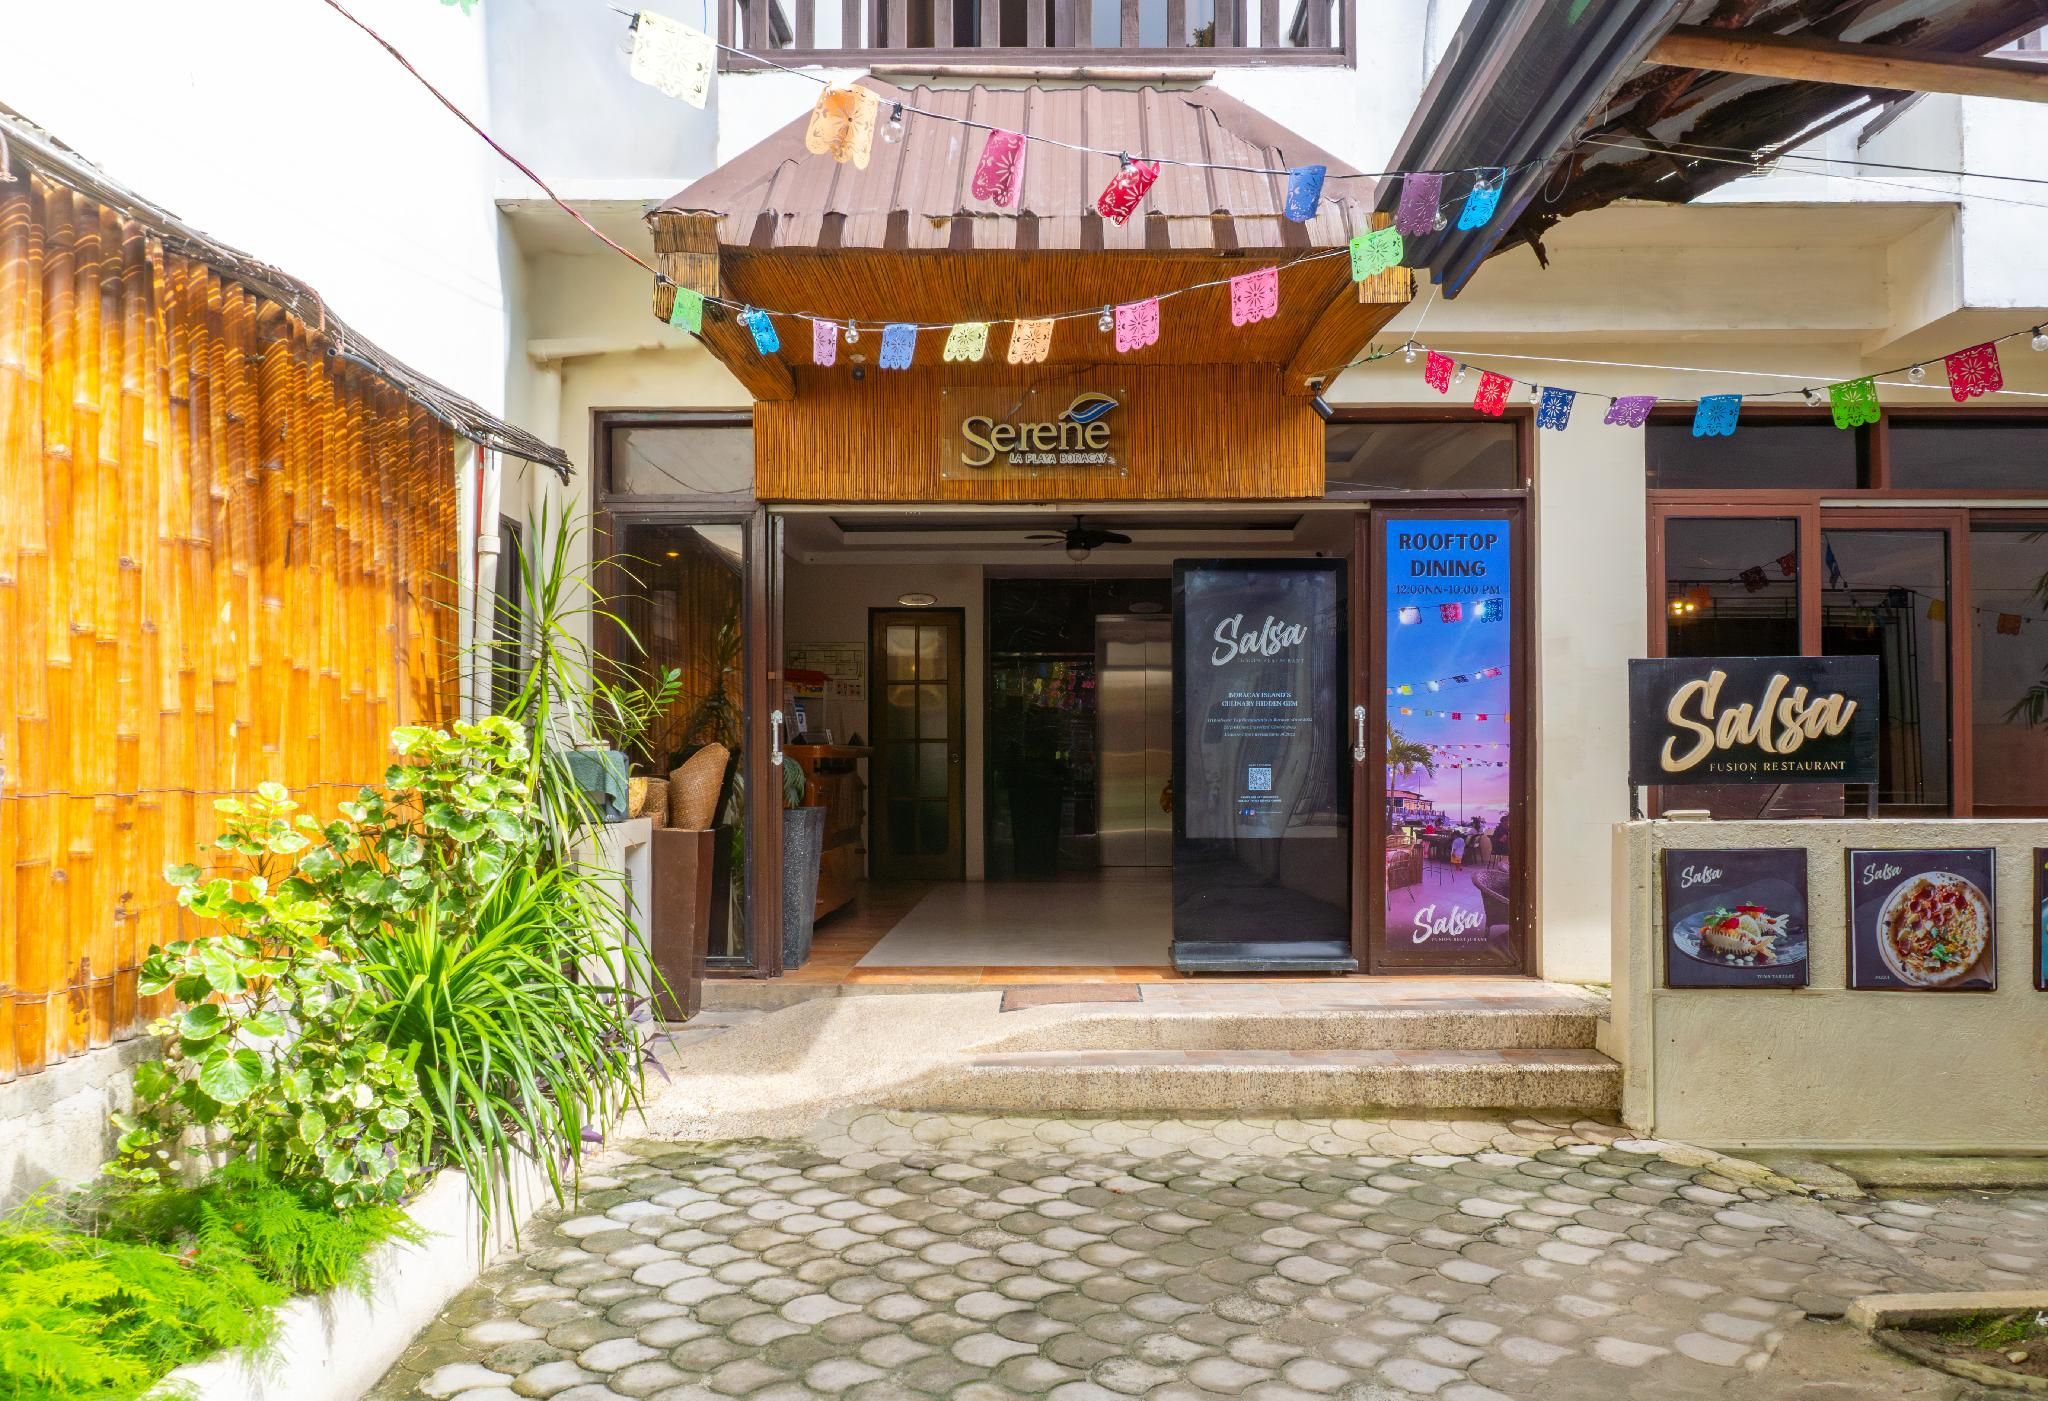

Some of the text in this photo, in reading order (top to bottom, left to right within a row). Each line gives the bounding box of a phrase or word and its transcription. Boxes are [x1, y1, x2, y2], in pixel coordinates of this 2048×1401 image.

[961, 415, 1111, 466] Serene
[1009, 453, 1109, 465] LA PLAYA BORACAY
[1399, 533, 1499, 551] ROOFTOP
[1411, 560, 1487, 577] DINING
[1482, 584, 1501, 595] PM
[1211, 613, 1308, 666] Salsa
[1660, 670, 1858, 773] Salsa
[1709, 761, 1847, 772] FUSION RESTAURANT
[1680, 865, 1723, 888] Salsa
[1863, 862, 1903, 885] Salsa
[1412, 904, 1484, 944] Salsa
